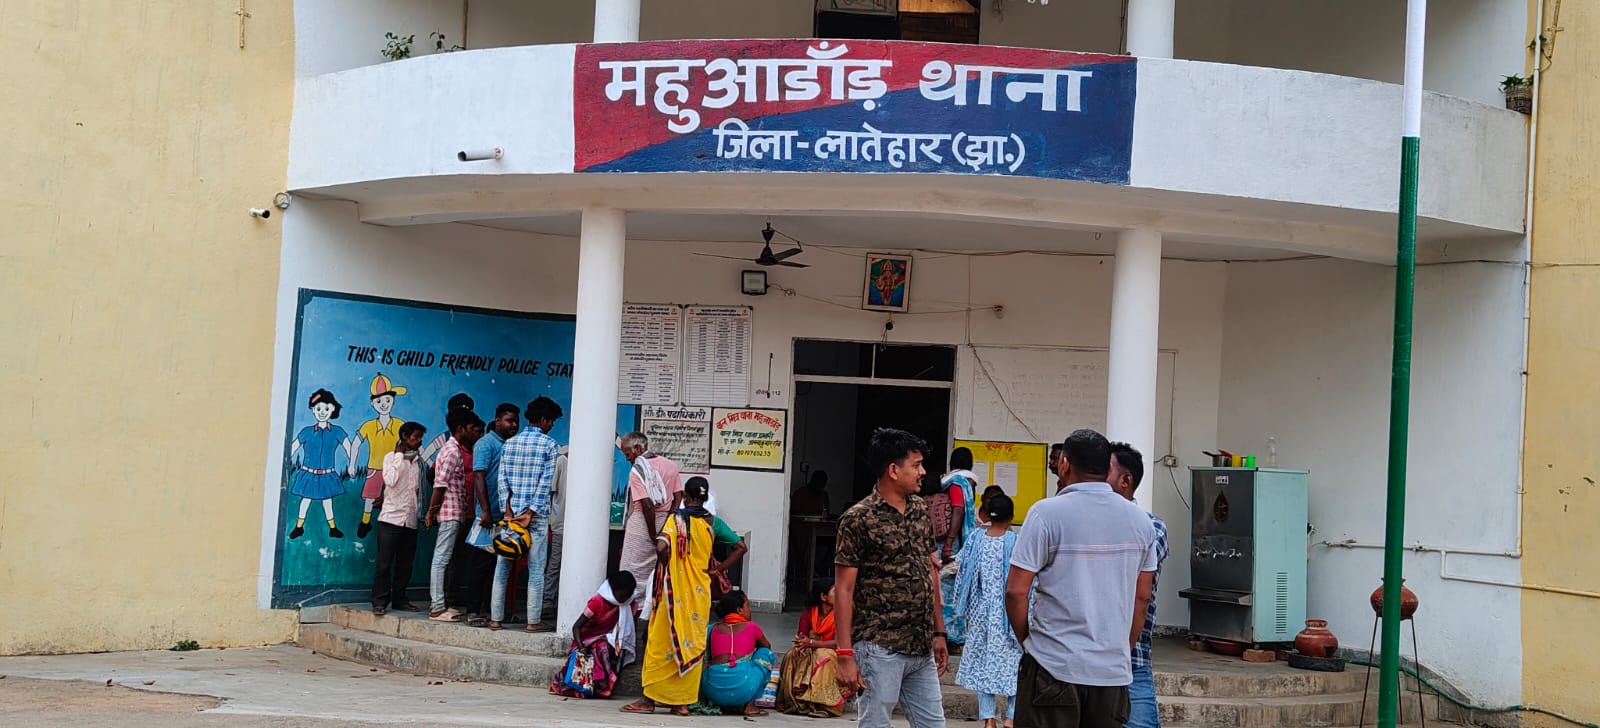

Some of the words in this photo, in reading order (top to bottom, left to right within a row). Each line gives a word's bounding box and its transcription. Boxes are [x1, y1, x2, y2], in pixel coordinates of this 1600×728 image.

[599, 41, 892, 134] महुआडाँड़
[919, 60, 1093, 112] थाना
[347, 345, 378, 364] THIS
[381, 348, 394, 365] IS
[396, 350, 435, 368] CHILD
[439, 353, 494, 375] FRIENDLY
[498, 358, 541, 376] POLICE
